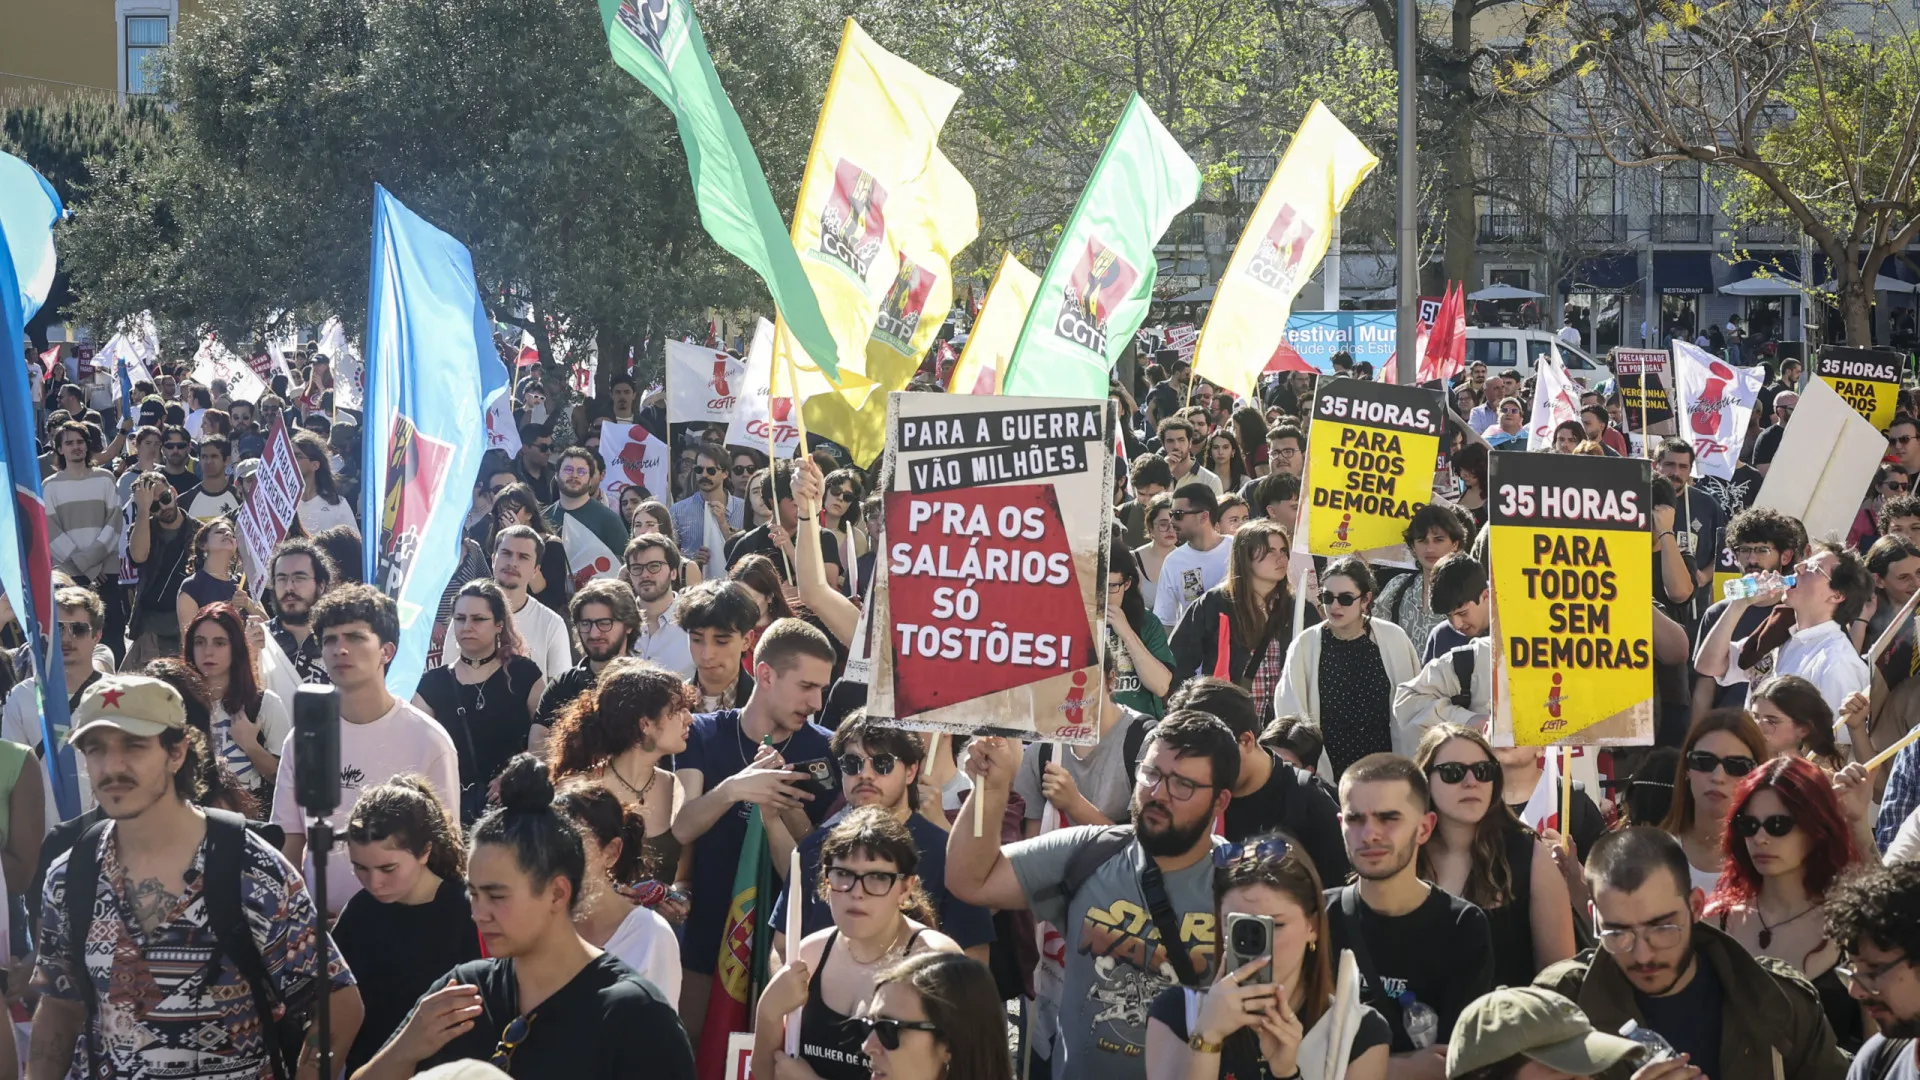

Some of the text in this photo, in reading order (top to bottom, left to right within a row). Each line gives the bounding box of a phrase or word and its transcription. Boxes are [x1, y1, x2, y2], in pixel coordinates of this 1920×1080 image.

[823, 233, 867, 277] CGTP
[876, 311, 912, 340] GTP
[1368, 342, 1397, 354] Estu
[1630, 363, 1662, 373] PORUGAL
[1822, 359, 1898, 382] 35 HORAS,
[1626, 399, 1669, 411] NACONAL
[1835, 381, 1876, 398] PARA
[1841, 396, 1878, 412] DOS
[903, 411, 1098, 447] PARA A GUERRA
[1320, 395, 1436, 433] 35 HORAS,
[1340, 427, 1403, 455] PARA
[1693, 438, 1729, 459] TP
[914, 444, 1085, 490] VÃO MILHÕES.
[1330, 447, 1406, 476] TODOS
[1345, 471, 1396, 497] SEM
[909, 500, 1045, 540] P'RA OS
[1499, 484, 1648, 528] 35 HORAS,
[889, 536, 1070, 585] SALÁRIOS
[1534, 534, 1612, 568] PARA
[931, 578, 980, 621] SÓ
[1522, 568, 1618, 601] TODOS
[1549, 603, 1610, 634] SEM
[896, 621, 1072, 669] TOSTÕES!
[1510, 637, 1651, 669] DEMORAS
[1087, 899, 1216, 943] STR
[803, 1043, 844, 1062] MULHER
[845, 1053, 859, 1065] DE
